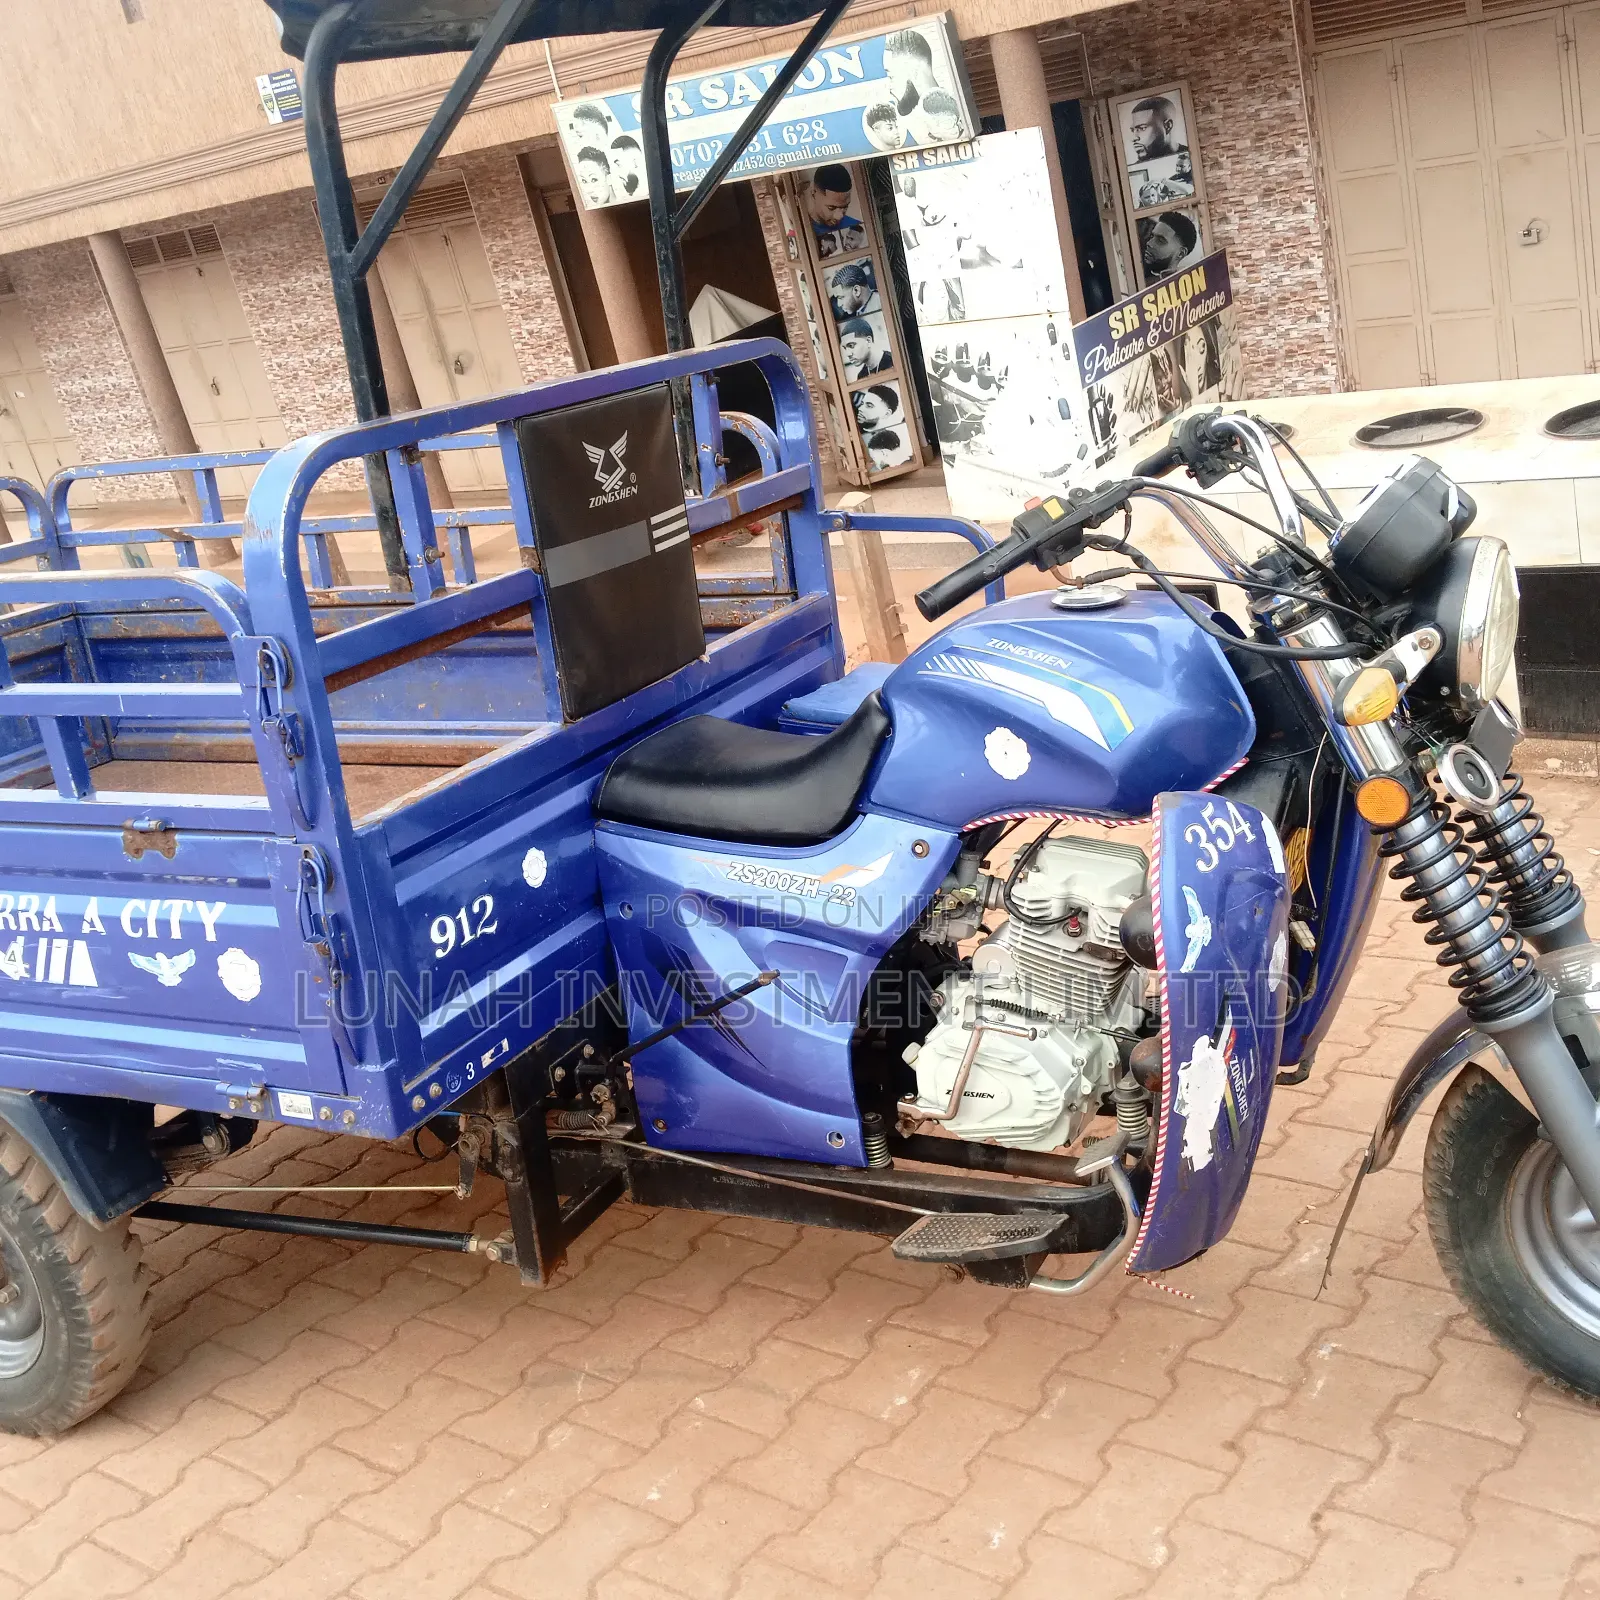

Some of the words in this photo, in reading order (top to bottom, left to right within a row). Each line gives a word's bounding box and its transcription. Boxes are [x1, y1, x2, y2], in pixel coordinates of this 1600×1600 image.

[670, 139, 723, 167] 0702
[782, 118, 828, 147] 628
[892, 152, 920, 171] SR
[1108, 303, 1140, 340] SR
[1141, 265, 1207, 322] SALON
[1083, 336, 1144, 384] Pedicure
[1146, 316, 1162, 348] &
[1162, 290, 1226, 336] Manicure
[588, 484, 639, 509] ZONGSHEN
[985, 637, 1074, 670] ZONGSHEN
[1184, 801, 1256, 873] 354
[726, 861, 857, 908] ZS200ZH-22
[120, 898, 227, 943] CITY
[430, 893, 499, 959] 912
[465, 1061, 476, 1081] 3
[945, 1088, 995, 1100] ZGSHEN
[1228, 1054, 1250, 1122] ZONGSHEN
